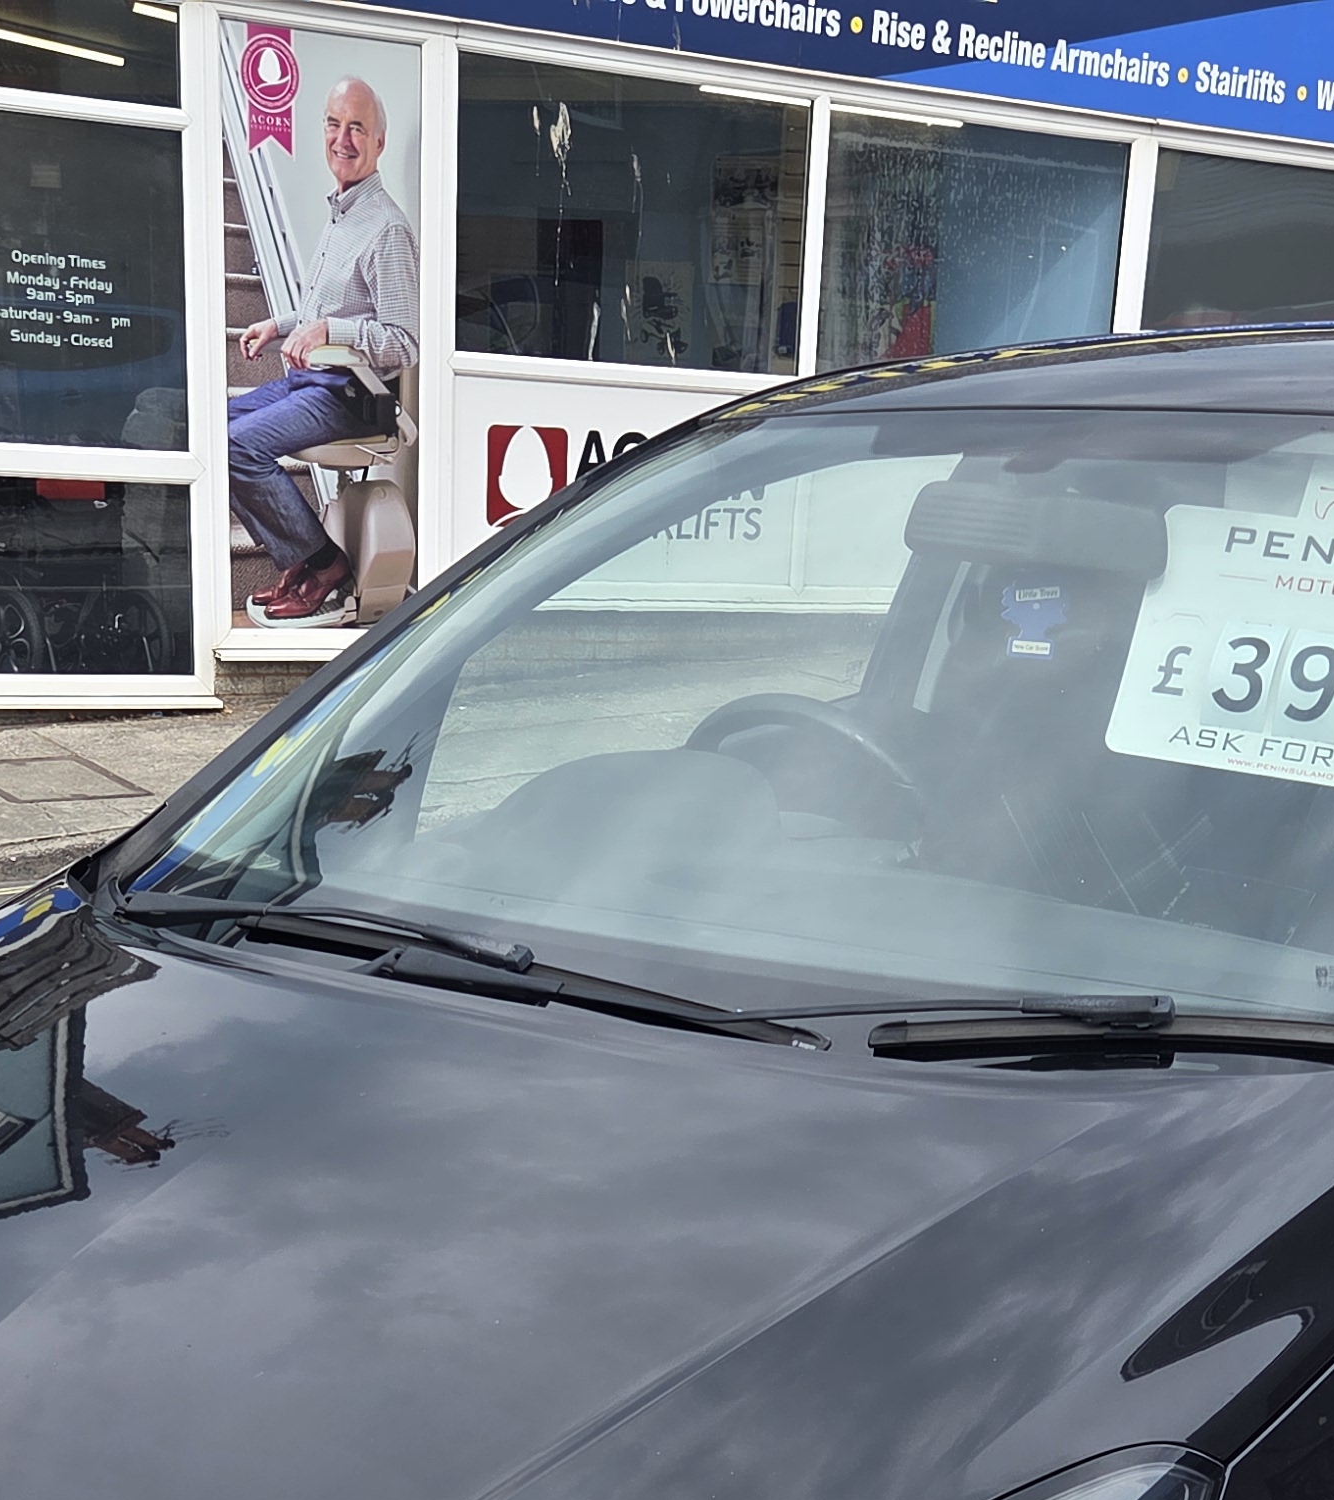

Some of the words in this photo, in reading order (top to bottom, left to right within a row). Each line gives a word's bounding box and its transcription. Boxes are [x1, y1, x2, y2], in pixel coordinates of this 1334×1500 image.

[872, 9, 926, 51] Rise
[931, 19, 952, 55] &
[957, 23, 1046, 69] Recline
[1051, 38, 1170, 87] Armchairs
[1194, 60, 1286, 104] Stairlifts
[250, 113, 291, 127] ACORN
[11, 249, 66, 269] Opening
[67, 254, 107, 270] Times
[6, 271, 60, 290] Monday
[69, 276, 113, 294] Friday
[26, 287, 56, 302] 9am
[65, 290, 95, 306] 5pm
[62, 311, 93, 325] 9am
[110, 316, 131, 329] pm
[10, 329, 61, 347] Sunday
[70, 333, 113, 348] Closed
[1168, 725, 1246, 754] ASK
[1260, 737, 1334, 767] FOR
